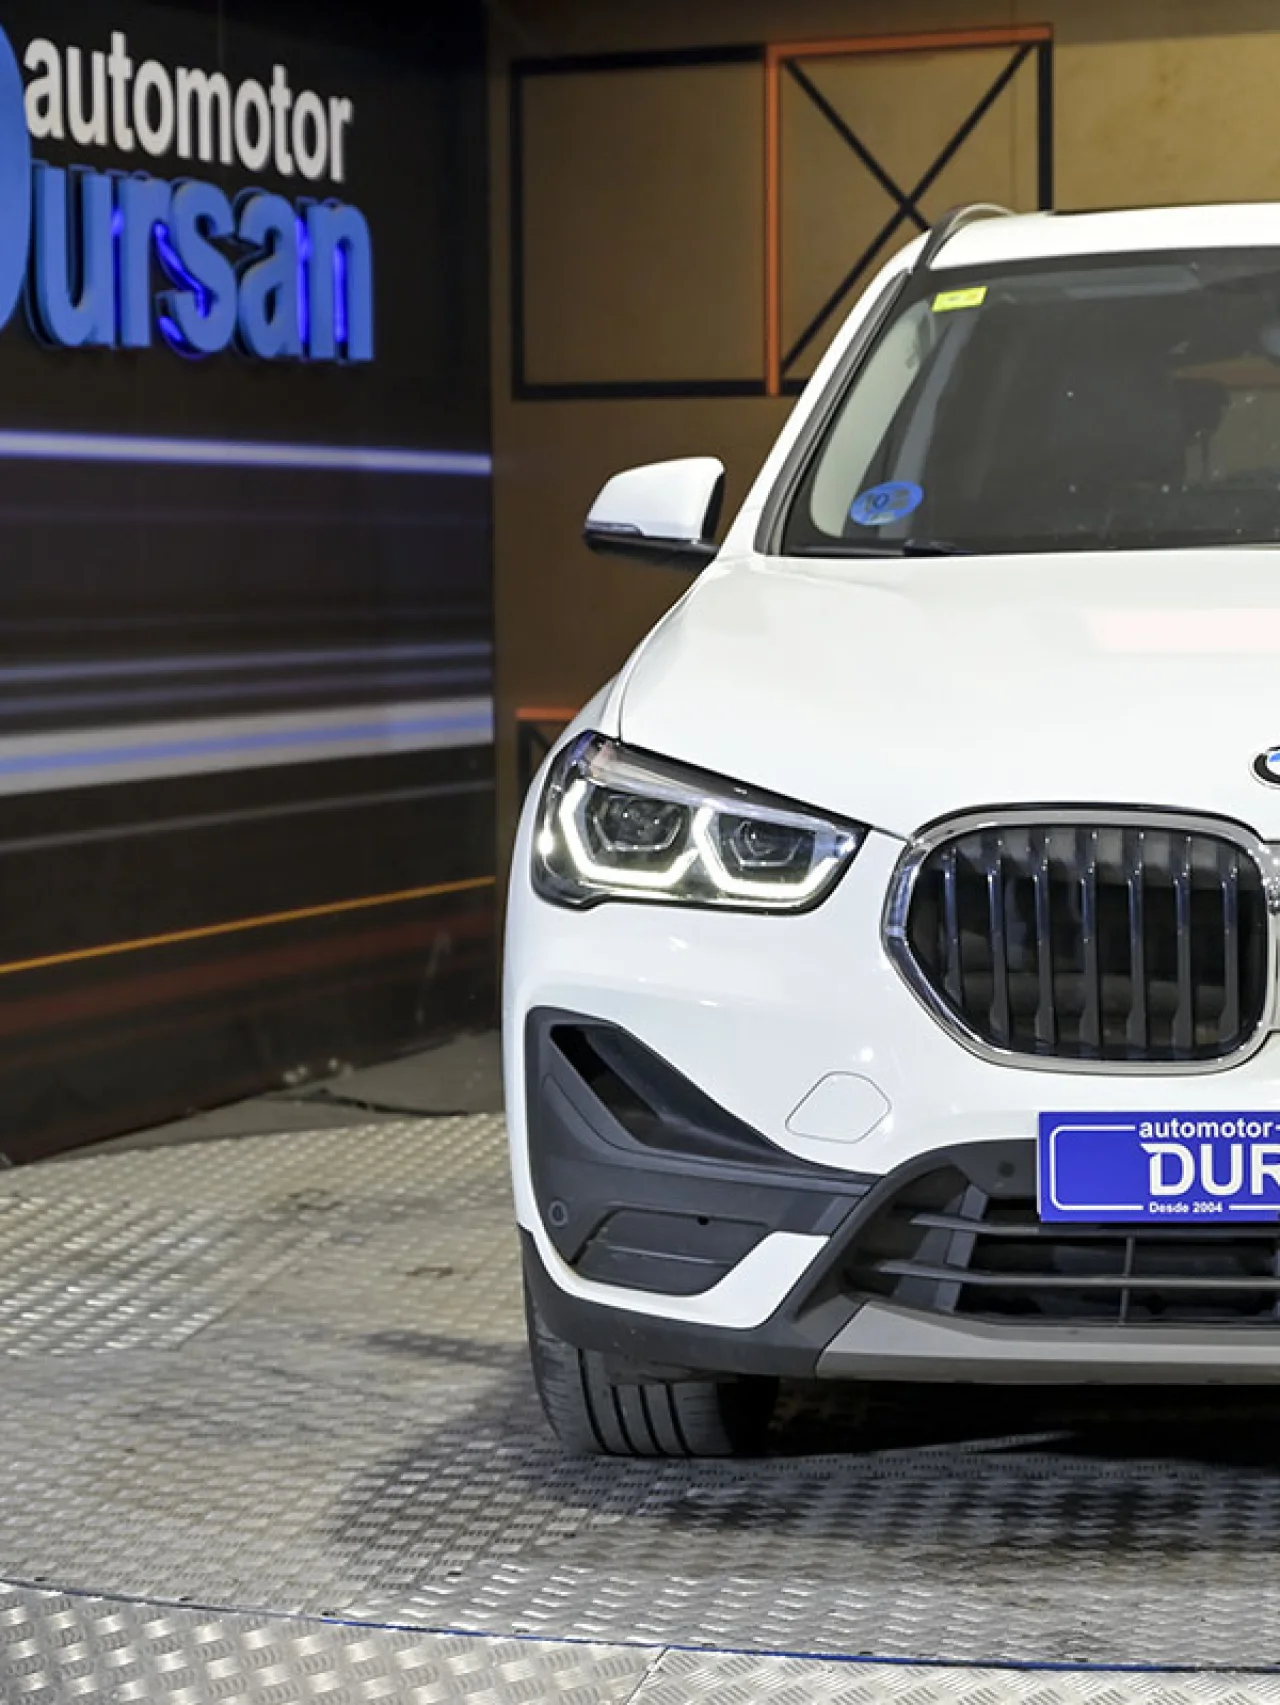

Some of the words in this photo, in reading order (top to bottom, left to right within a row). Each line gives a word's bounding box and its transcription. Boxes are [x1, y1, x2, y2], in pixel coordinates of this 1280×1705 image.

[24, 31, 353, 183] automotor
[0, 24, 374, 361] ursan
[1139, 1118, 1273, 1138] automotor
[1149, 1201, 1189, 1212] Desde
[1192, 1201, 1222, 1212] 2004
